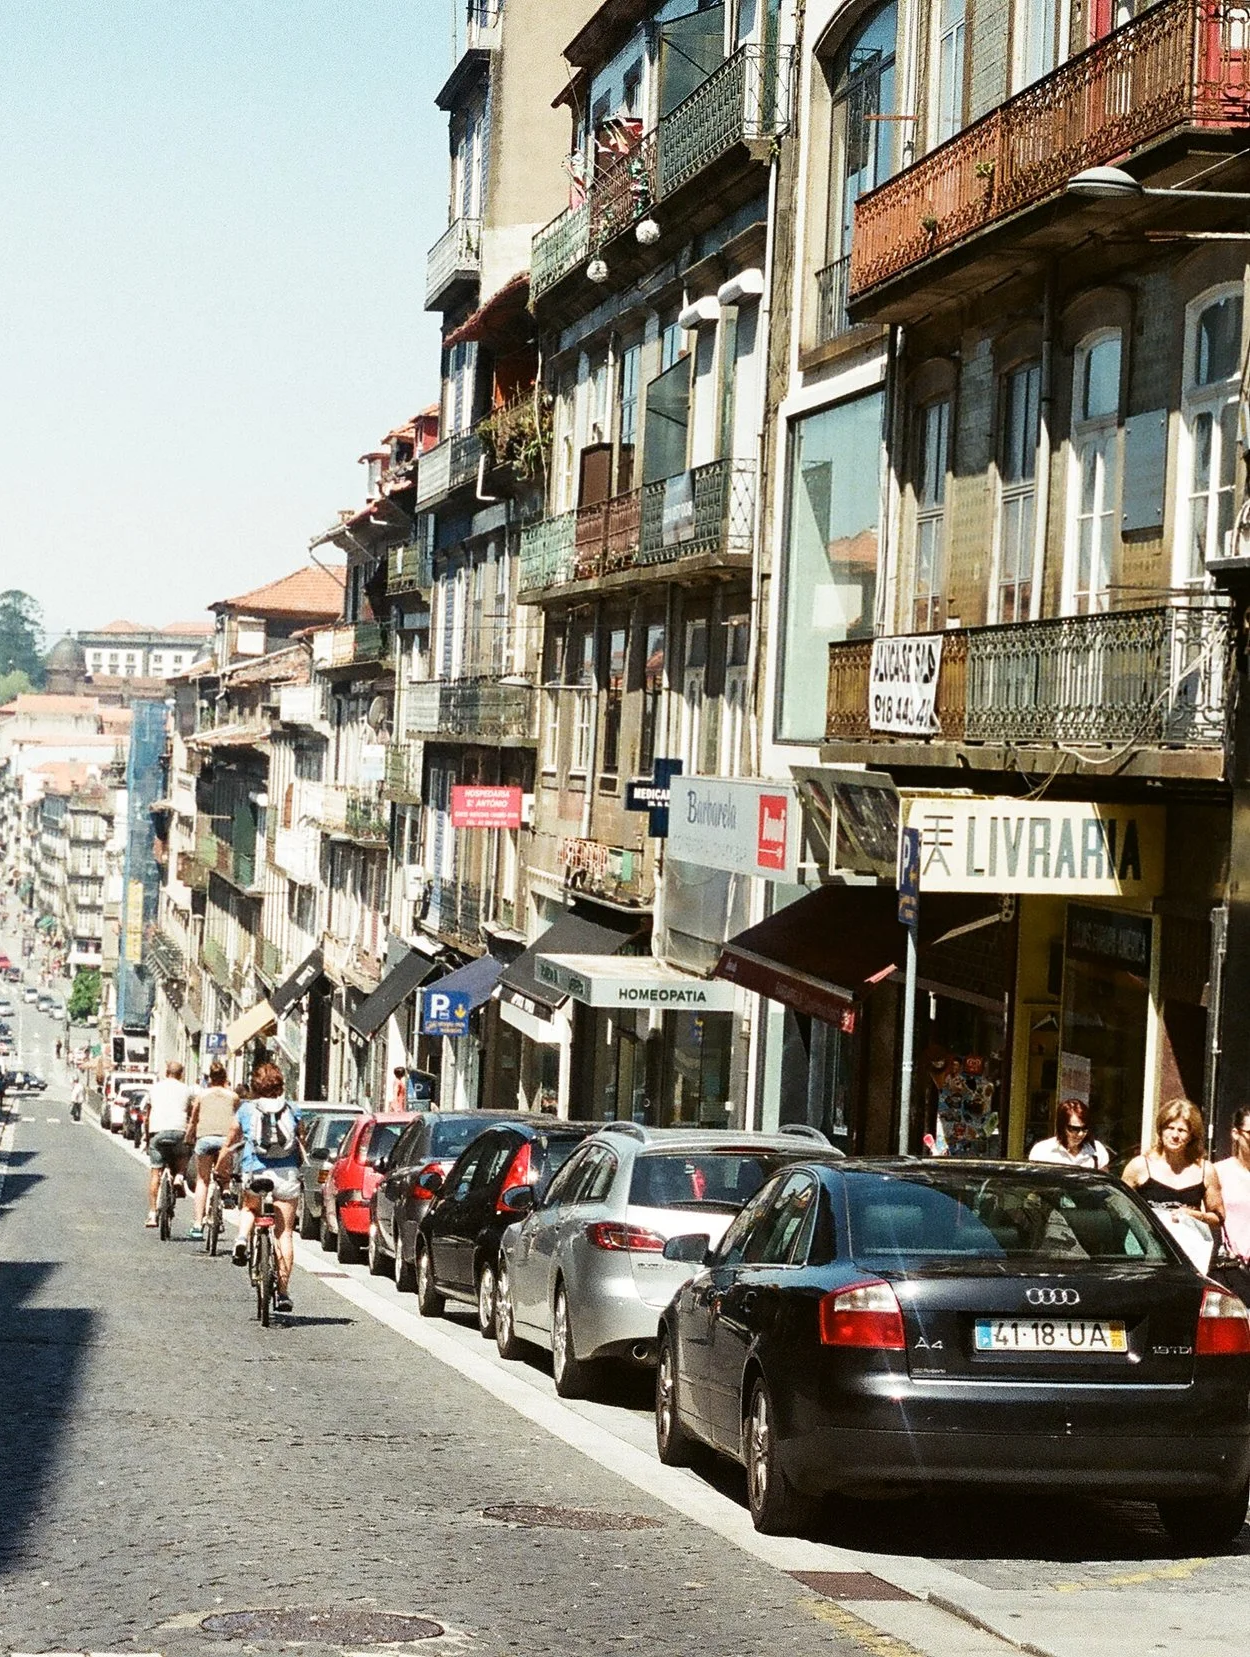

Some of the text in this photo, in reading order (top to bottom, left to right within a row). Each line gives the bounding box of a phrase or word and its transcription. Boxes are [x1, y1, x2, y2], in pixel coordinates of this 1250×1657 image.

[875, 694, 893, 724] 918
[464, 789, 510, 798] HOSPEDARIA
[967, 816, 1141, 881] LIVRARIA
[619, 988, 707, 1003] HOMEOPATIA
[430, 993, 451, 1019] P
[914, 1336, 944, 1350] A4
